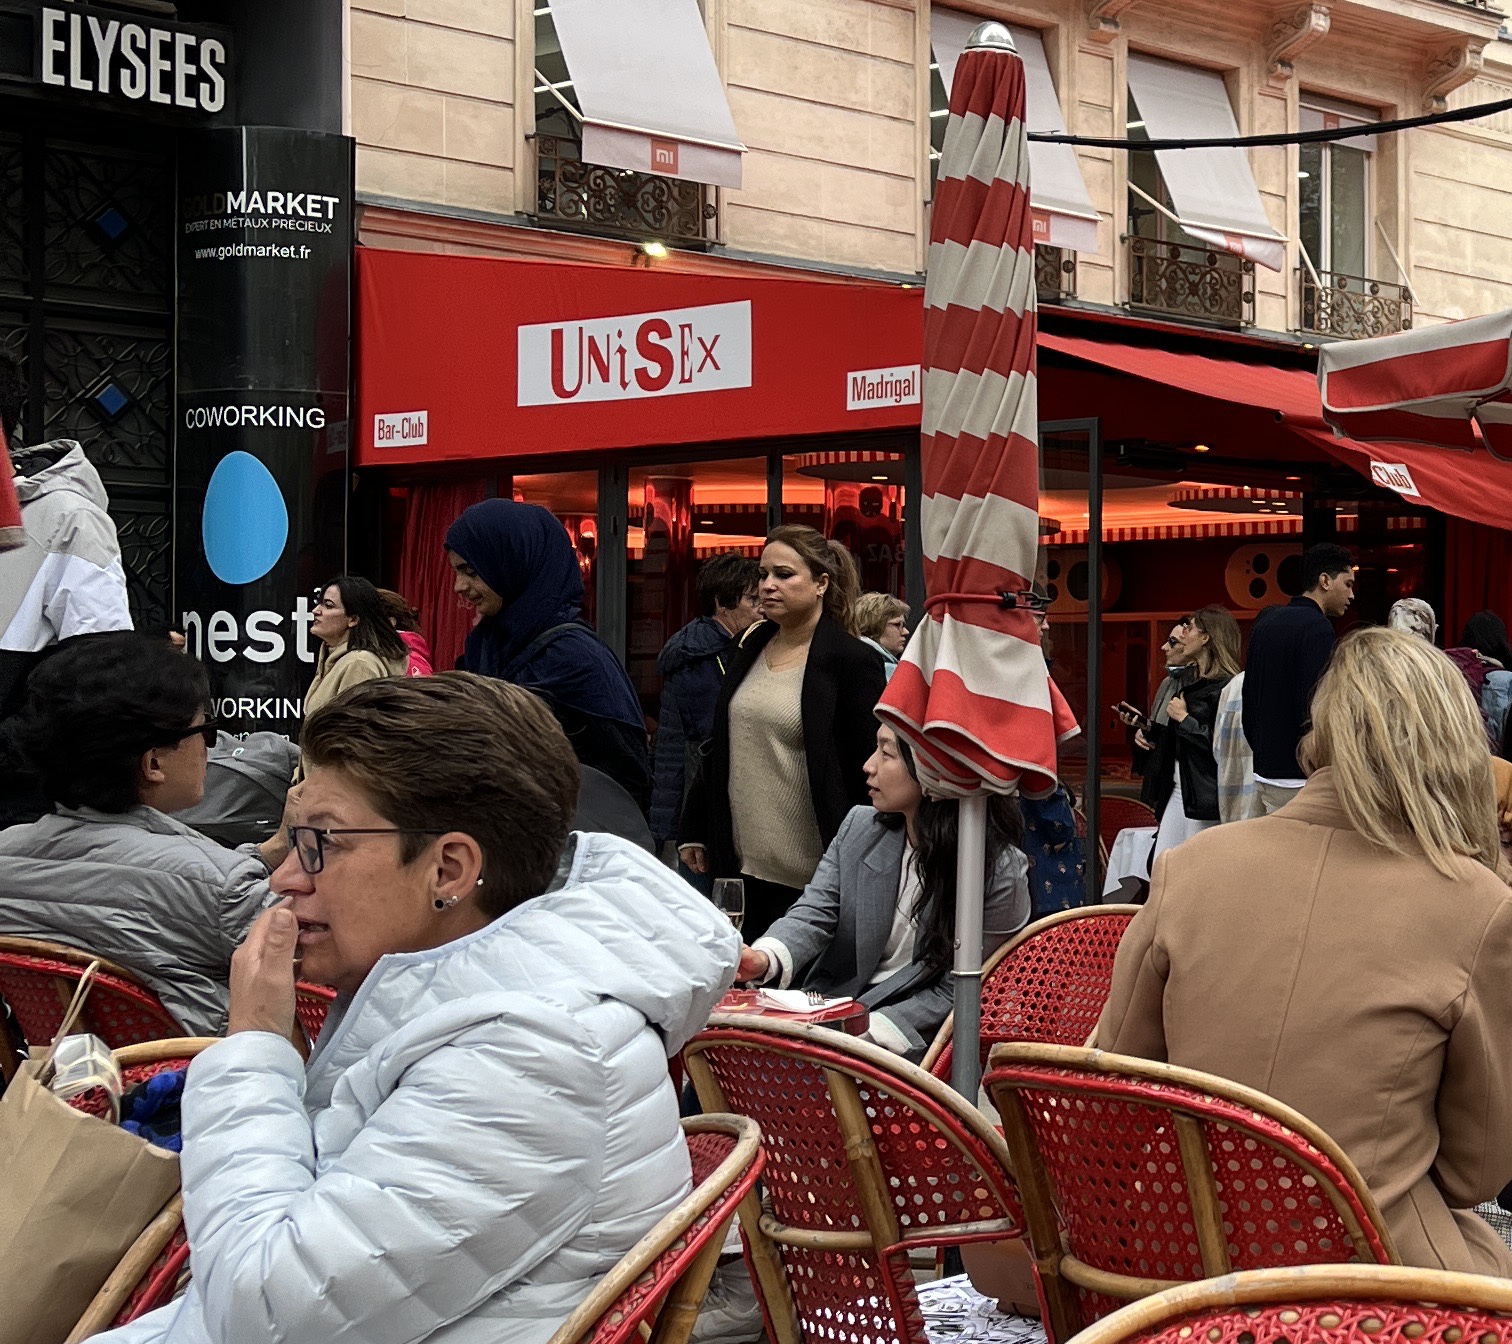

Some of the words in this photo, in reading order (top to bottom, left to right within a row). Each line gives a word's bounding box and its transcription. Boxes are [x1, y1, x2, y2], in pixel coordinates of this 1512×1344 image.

[42, 7, 225, 113] ELYSEES
[223, 215, 270, 230] MÉTAUX
[272, 216, 332, 234] PRÉCIEUX
[194, 243, 312, 261] www.goldmarket.fr
[851, 371, 916, 404] Madrigal
[185, 405, 326, 429] COWORKING
[377, 416, 424, 441] Bar-Club
[1371, 465, 1412, 489] Club
[210, 697, 301, 719] WORKIN
